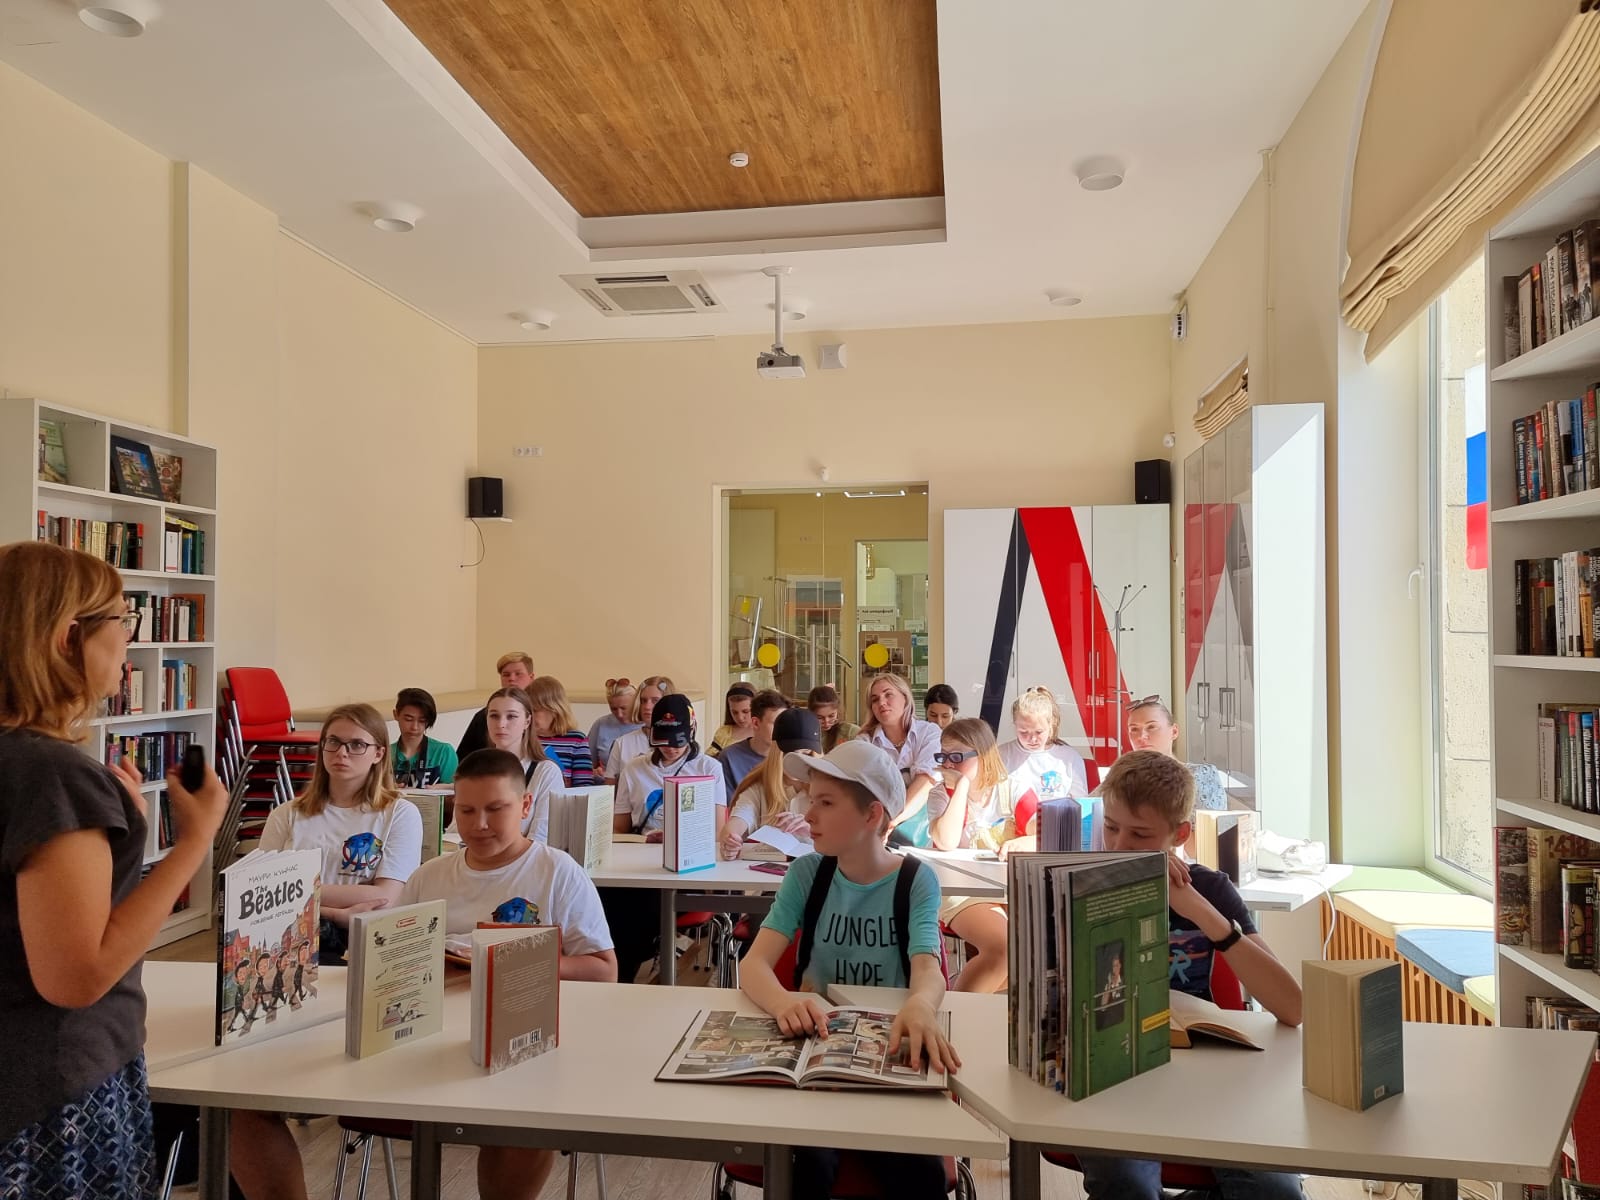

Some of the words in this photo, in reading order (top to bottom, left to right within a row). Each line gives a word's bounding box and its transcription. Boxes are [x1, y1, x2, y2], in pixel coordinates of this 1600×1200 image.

[238, 878, 304, 920] Beatles
[254, 885, 268, 895] The
[823, 912, 898, 948] JUNGLE
[835, 959, 884, 986] HYPE
